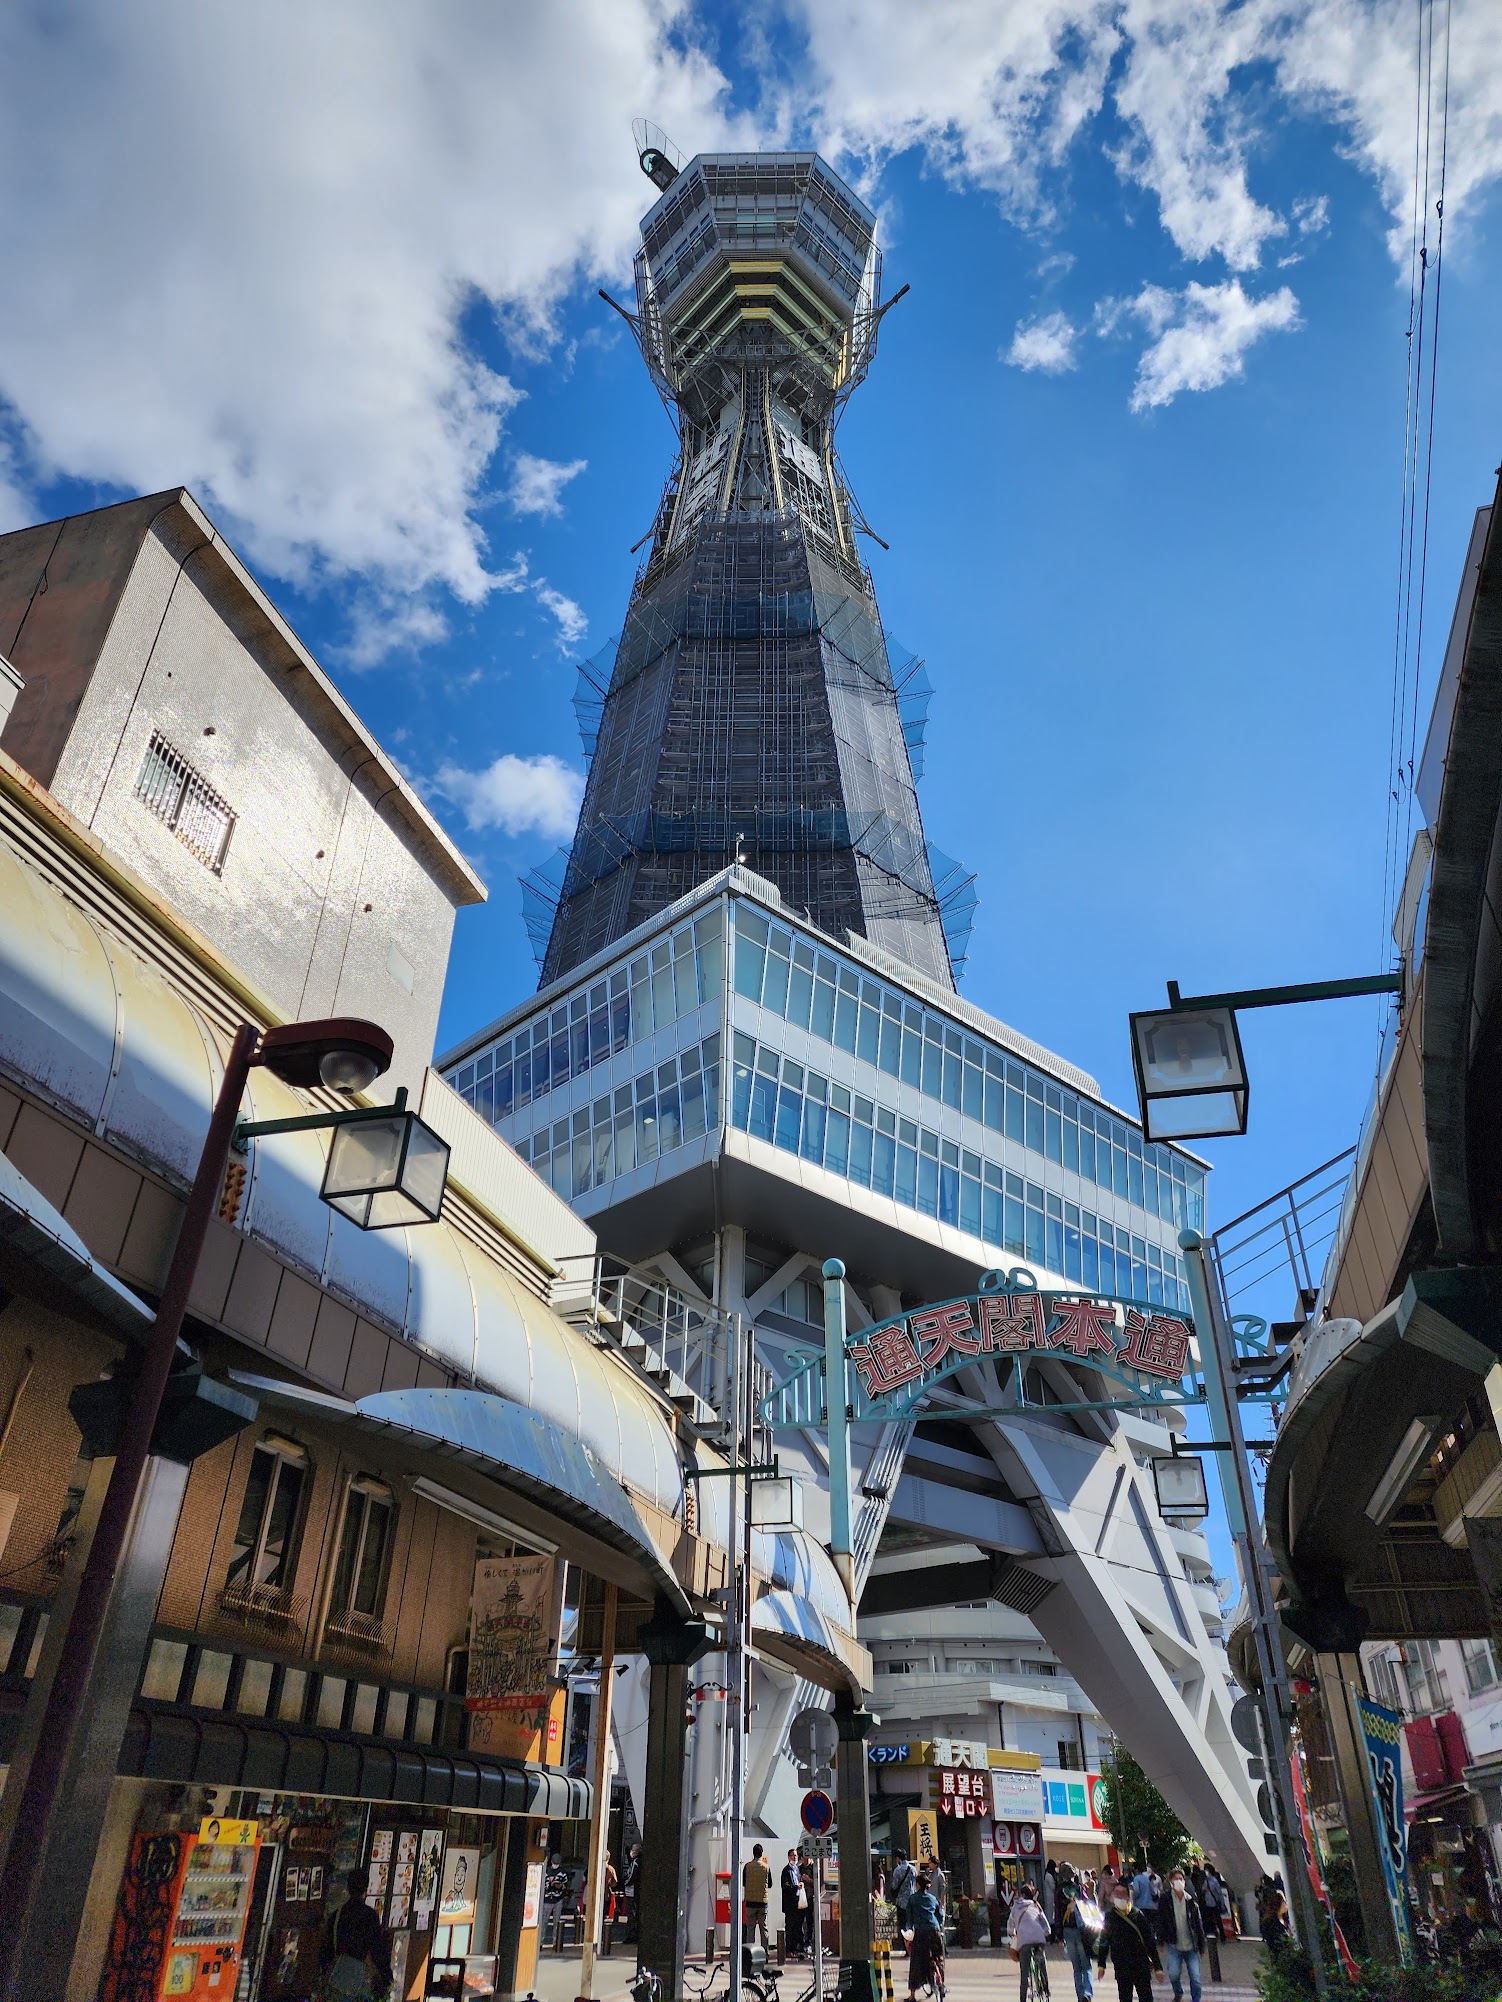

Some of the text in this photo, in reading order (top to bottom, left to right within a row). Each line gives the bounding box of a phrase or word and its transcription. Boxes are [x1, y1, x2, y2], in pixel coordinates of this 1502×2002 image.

[849, 1292, 1192, 1400] 通天閣本通
[868, 1744, 908, 1762] くランド
[932, 1737, 989, 1770] 通天閣
[942, 1772, 984, 1797] 展望台
[804, 1847, 832, 1857] ここまで
[920, 1822, 933, 1858] 王将
